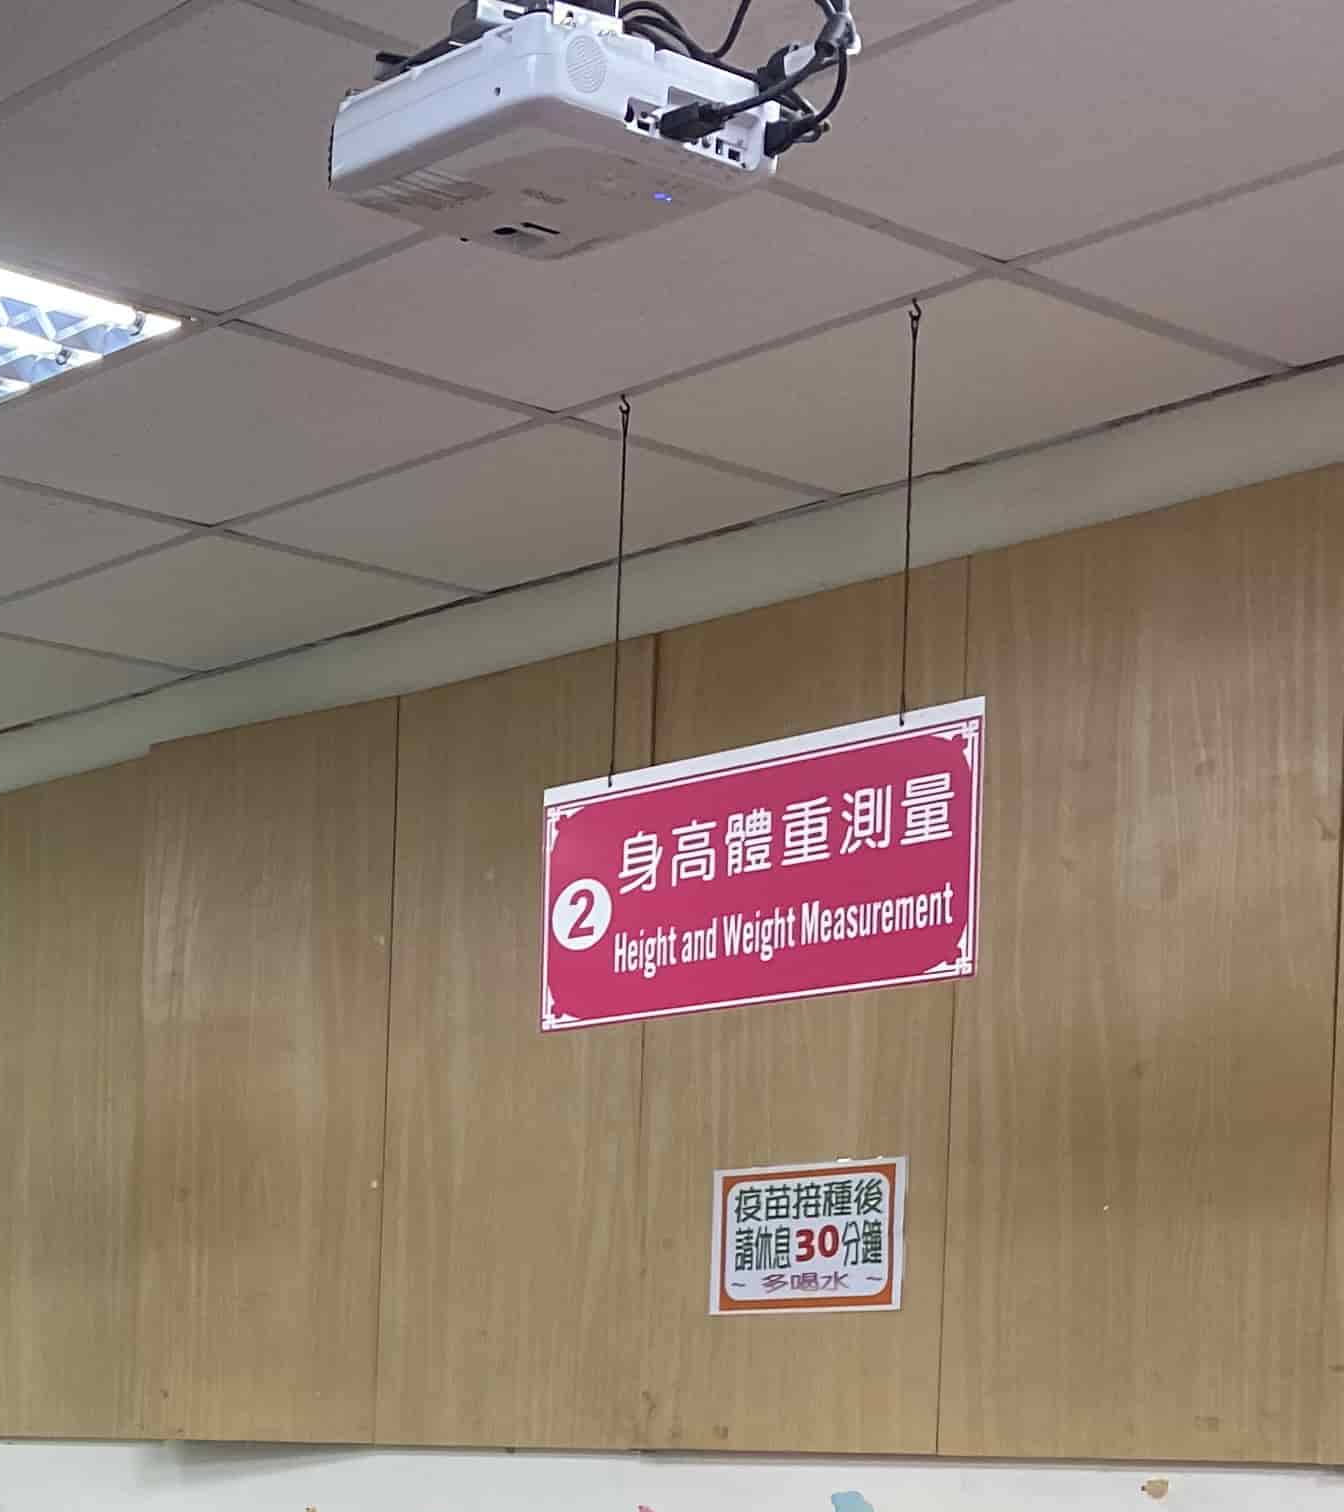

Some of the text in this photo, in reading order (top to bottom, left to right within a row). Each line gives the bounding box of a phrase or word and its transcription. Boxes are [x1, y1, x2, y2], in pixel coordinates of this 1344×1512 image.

[617, 771, 955, 895] 身高體重測量
[613, 881, 955, 978] Height and Weight Measurement
[734, 1178, 883, 1223] 疫苗接種後
